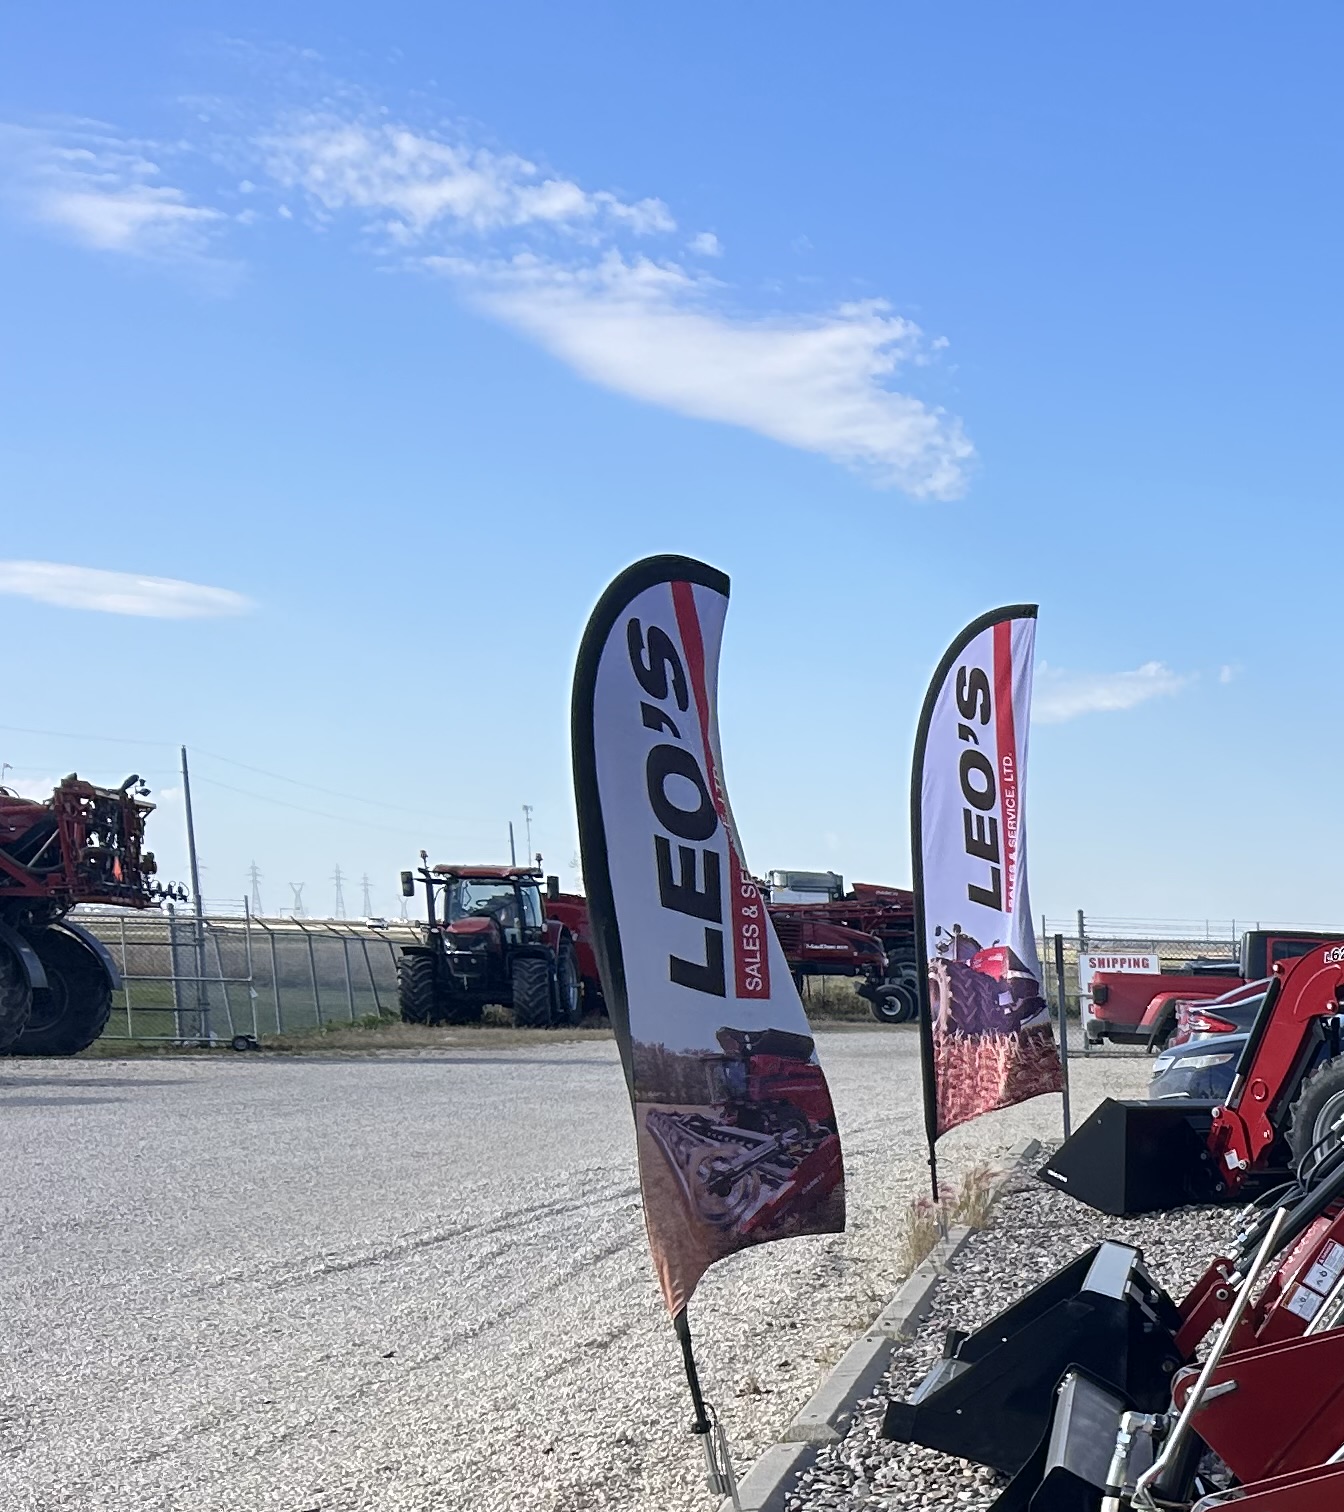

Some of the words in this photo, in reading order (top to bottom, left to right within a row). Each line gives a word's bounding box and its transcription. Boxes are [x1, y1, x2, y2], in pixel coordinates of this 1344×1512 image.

[956, 666, 1002, 912] LEO'S
[1003, 752, 1014, 782] LTD.
[627, 617, 727, 998] LEO'S
[741, 902, 759, 918] &
[743, 922, 763, 991] SALES
[1089, 957, 1150, 969] SHIPPING
